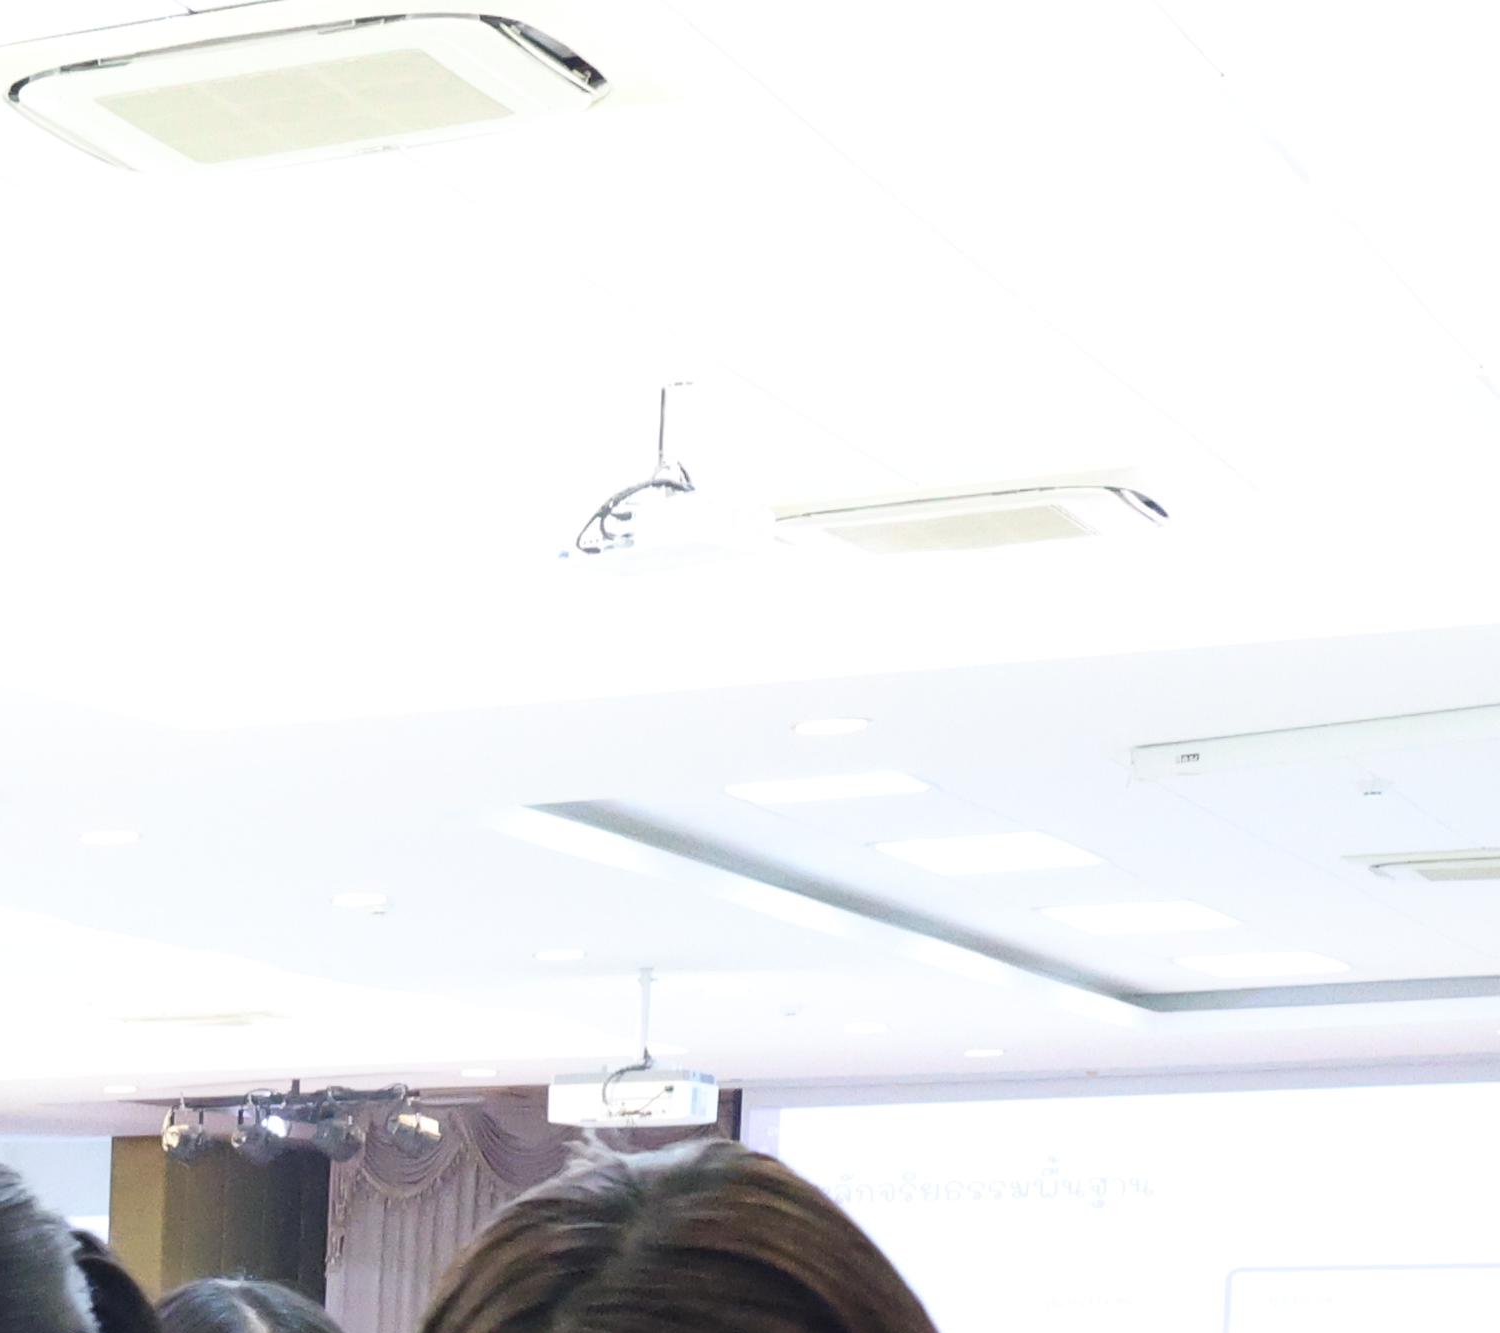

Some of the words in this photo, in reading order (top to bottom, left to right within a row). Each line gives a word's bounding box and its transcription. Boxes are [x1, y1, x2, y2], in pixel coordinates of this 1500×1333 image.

[825, 1152, 1155, 1209] ลักจริยธรรมพื้นฐาน
